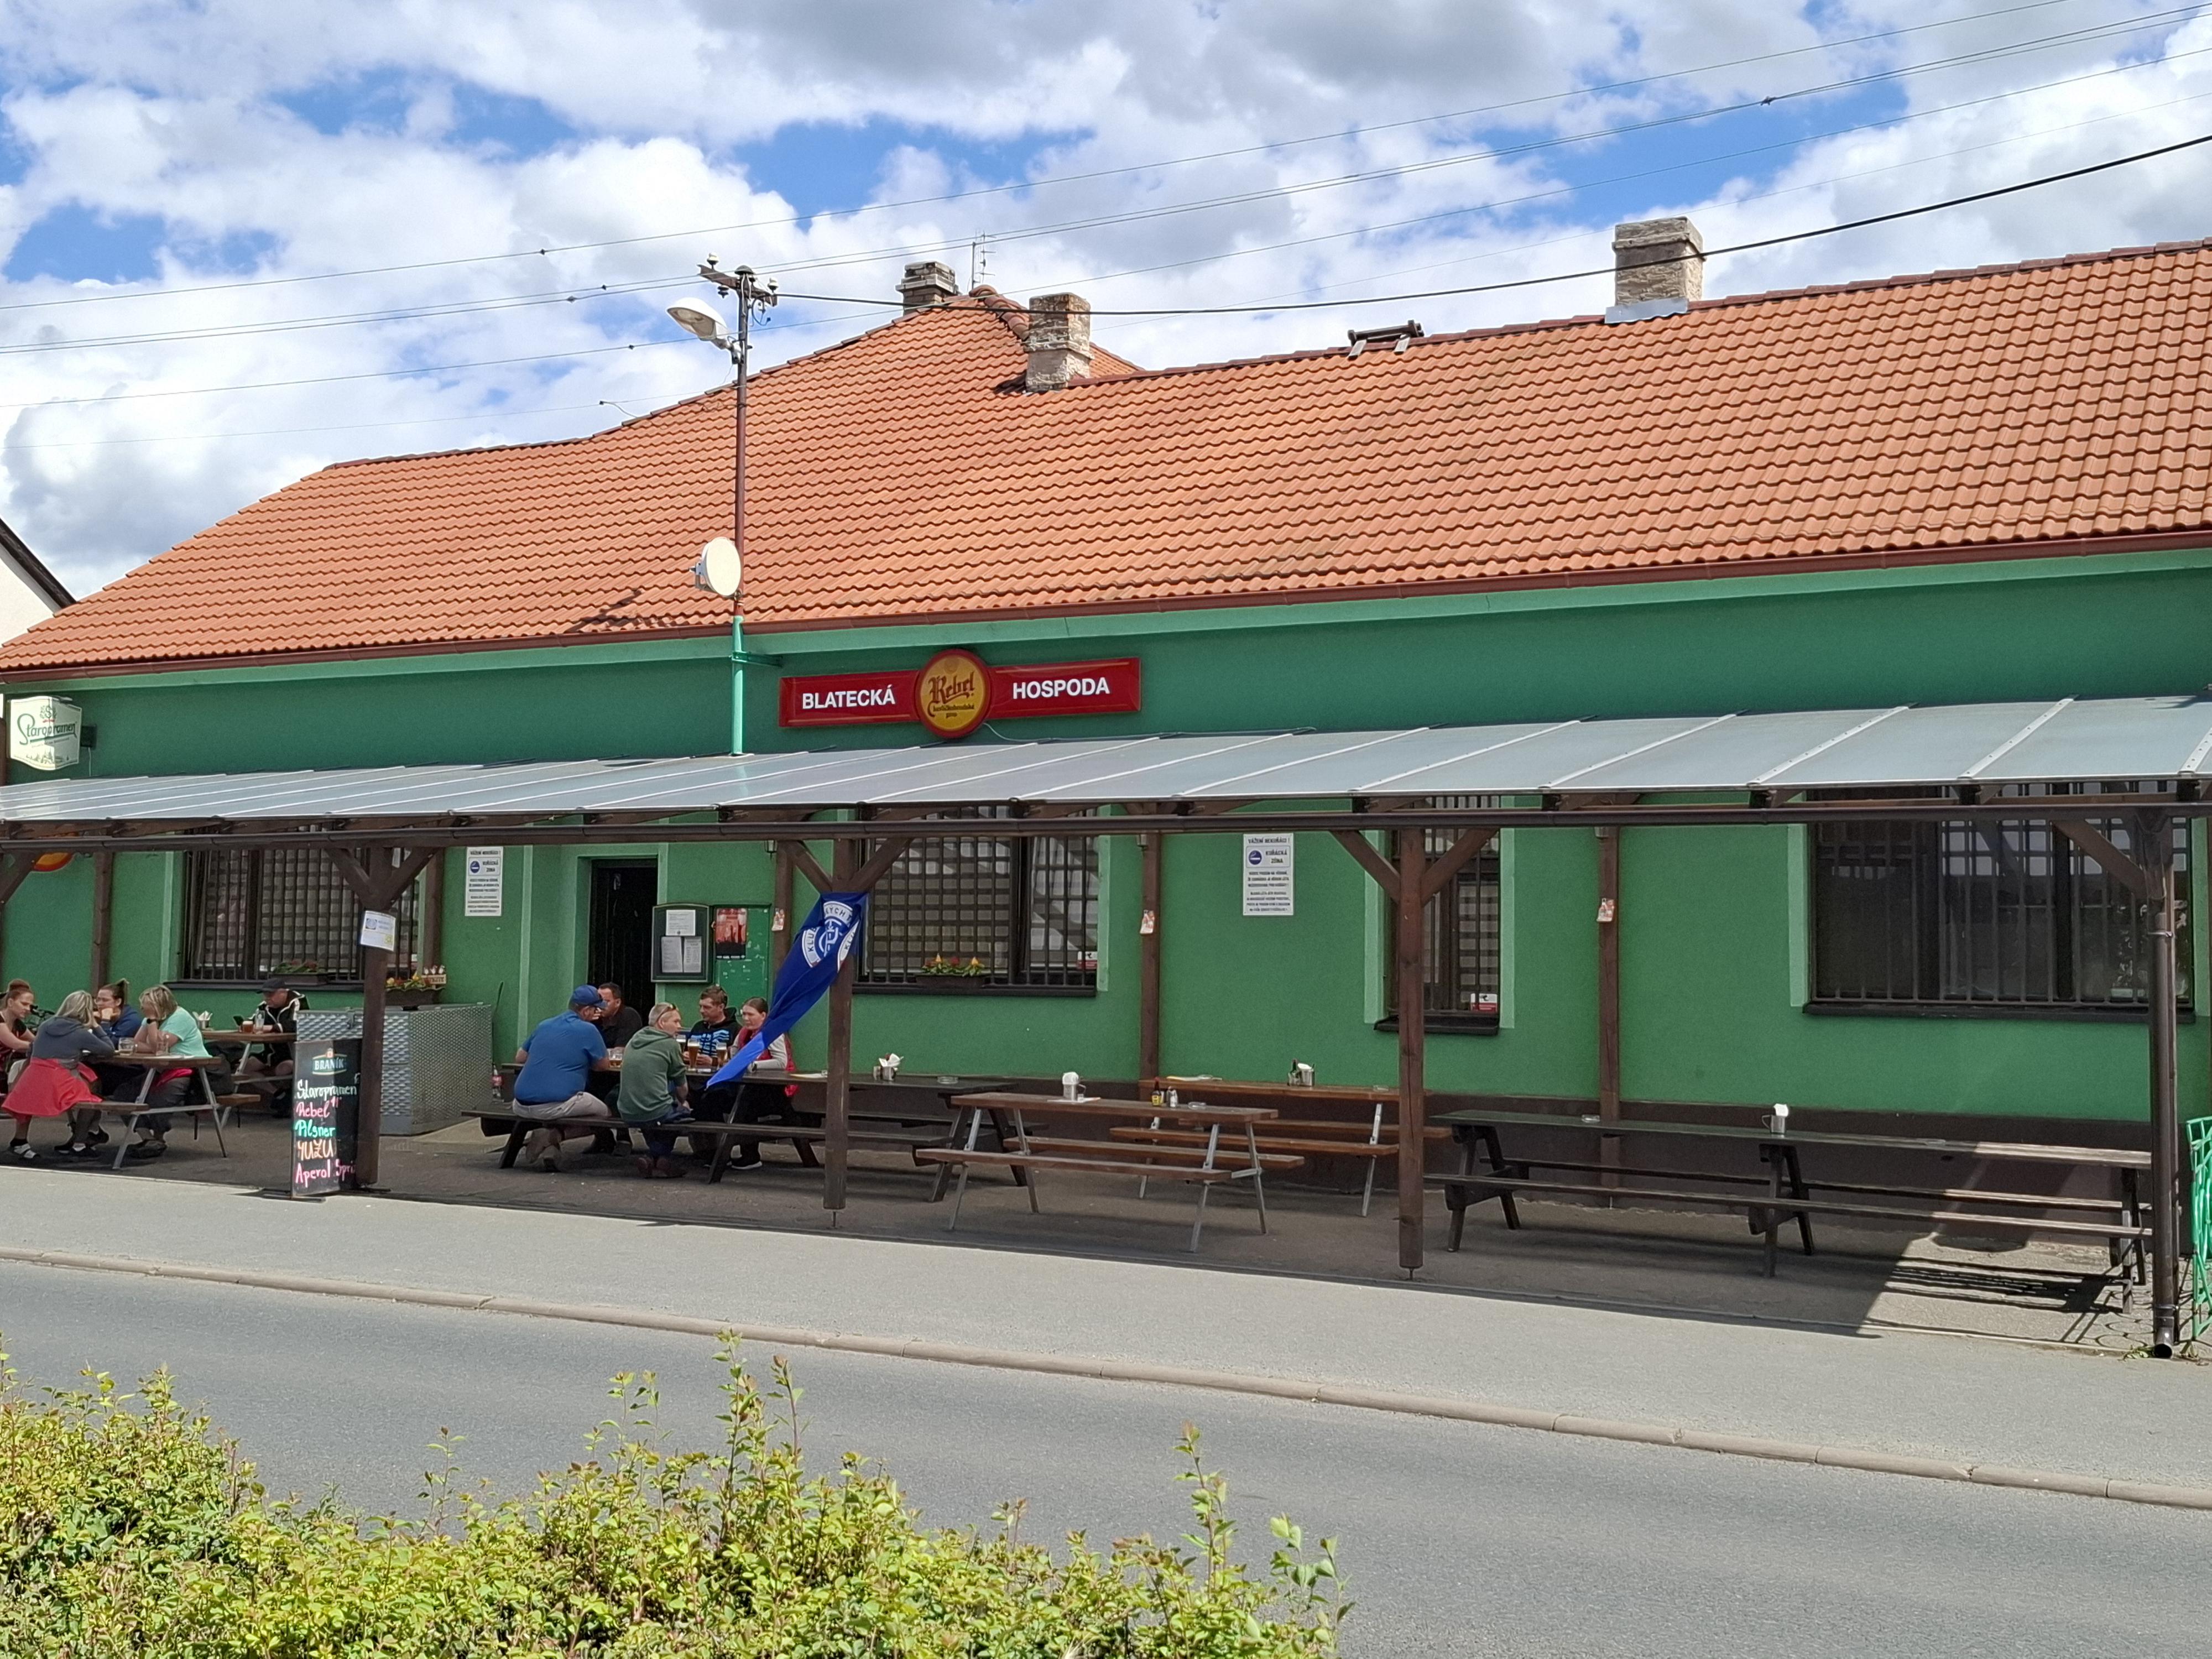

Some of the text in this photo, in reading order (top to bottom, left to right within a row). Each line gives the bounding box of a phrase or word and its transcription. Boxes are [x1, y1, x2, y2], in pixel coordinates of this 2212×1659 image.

[802, 677, 1110, 709] BLATECKÁ HOSPODA
[928, 671, 975, 705] Rebel
[17, 713, 77, 745] Staropramen
[315, 1057, 344, 1070] BRANÍK
[297, 1079, 357, 1101] Staropramen
[296, 1100, 330, 1118] Rebel
[295, 1119, 336, 1138] Pilsner
[295, 1159, 356, 1188] Aperol Spri
